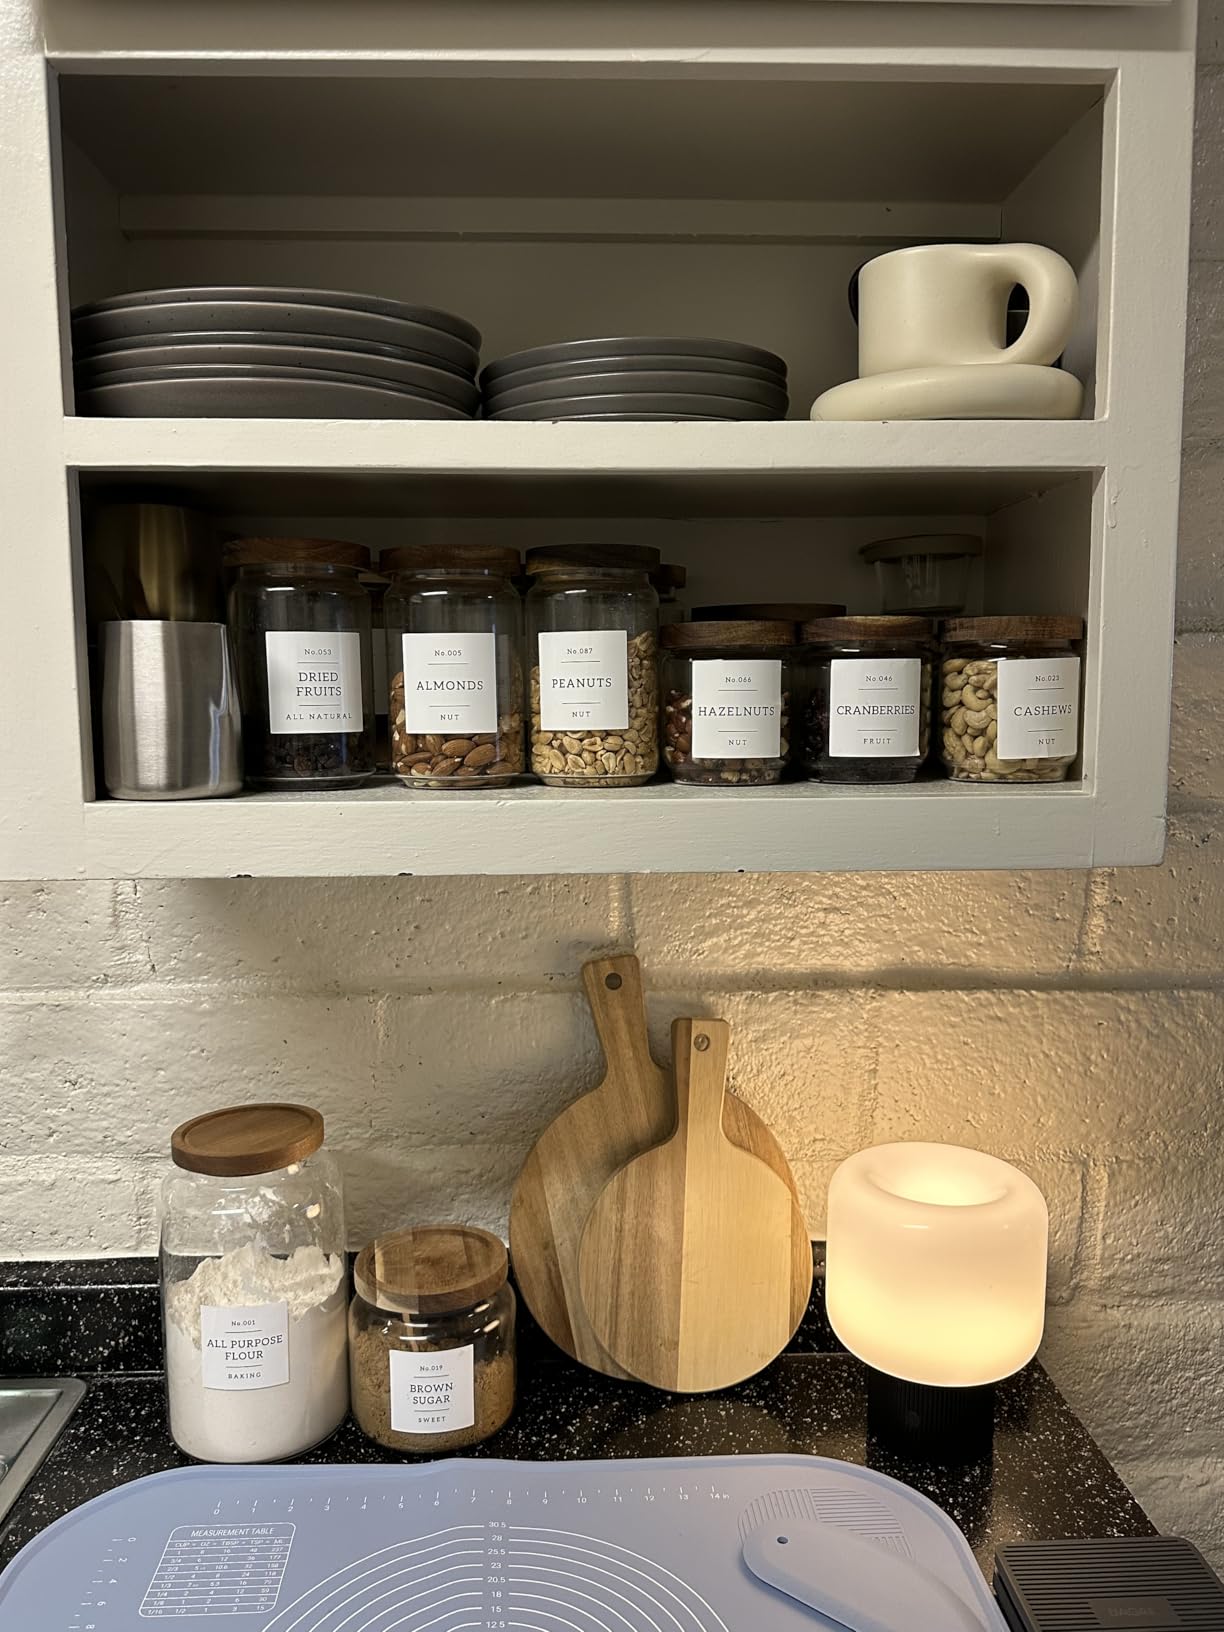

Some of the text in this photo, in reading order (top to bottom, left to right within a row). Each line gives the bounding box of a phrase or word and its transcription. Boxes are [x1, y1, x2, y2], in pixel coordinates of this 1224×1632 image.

[304, 648, 332, 656] No.053
[298, 671, 339, 683] DRIED
[416, 680, 484, 691] ALMONDS
[551, 677, 612, 689] PEANUTS
[296, 686, 342, 697] FRUITS
[698, 706, 775, 717] HAZELNUTS
[836, 705, 915, 716] CRANBERRIES
[1014, 704, 1072, 717] CASHEWS
[286, 712, 353, 721] ALL NATURAL
[207, 1334, 283, 1349] ALL PURPOSE
[225, 1350, 263, 1361] FLOUR
[410, 1383, 453, 1393] BROWN
[413, 1395, 450, 1405] SUGAR
[491, 1534, 503, 1542] 28
[490, 1562, 502, 1570] 23
[487, 1576, 506, 1584] 20.5
[491, 1591, 502, 1599] 18
[491, 1606, 502, 1614] 15
